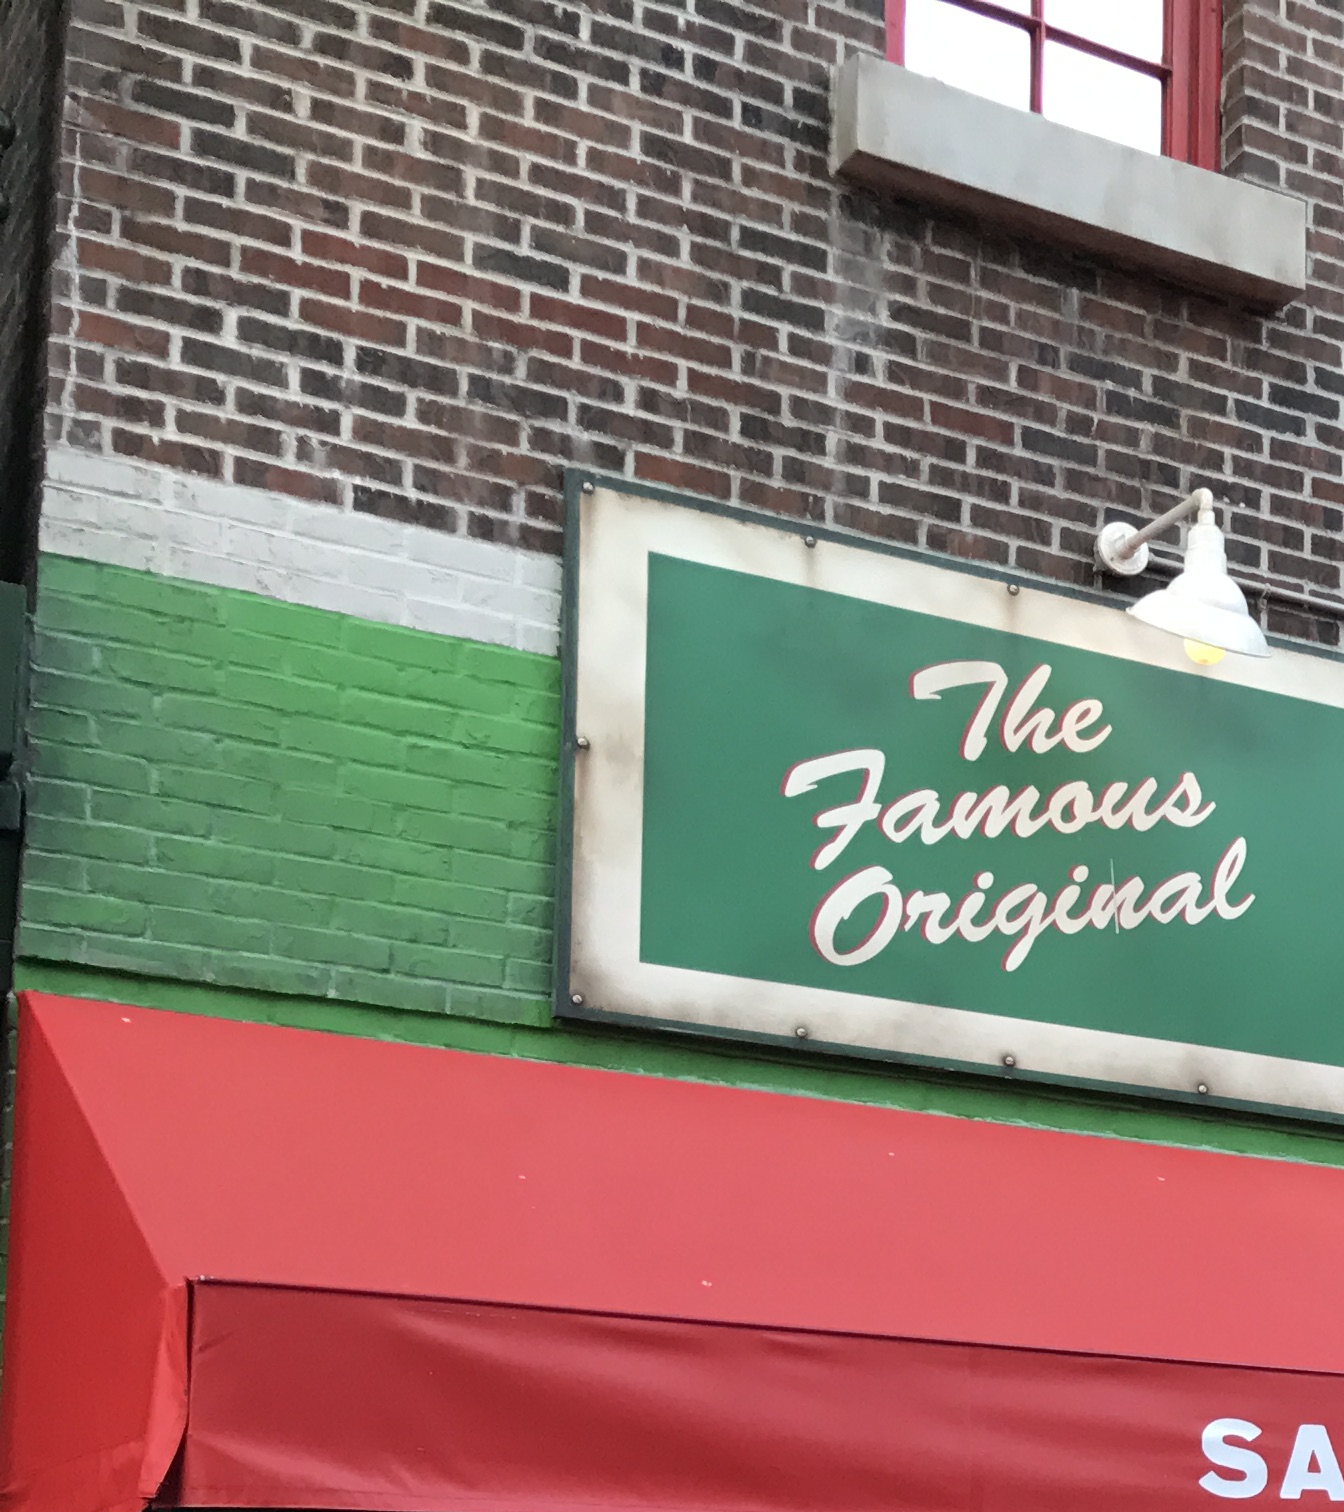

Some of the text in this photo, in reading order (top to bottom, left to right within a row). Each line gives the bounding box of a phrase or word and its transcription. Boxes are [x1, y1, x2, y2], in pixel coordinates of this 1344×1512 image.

[911, 660, 1113, 762] The
[781, 747, 1217, 872] Famous
[810, 836, 1256, 972] Original
